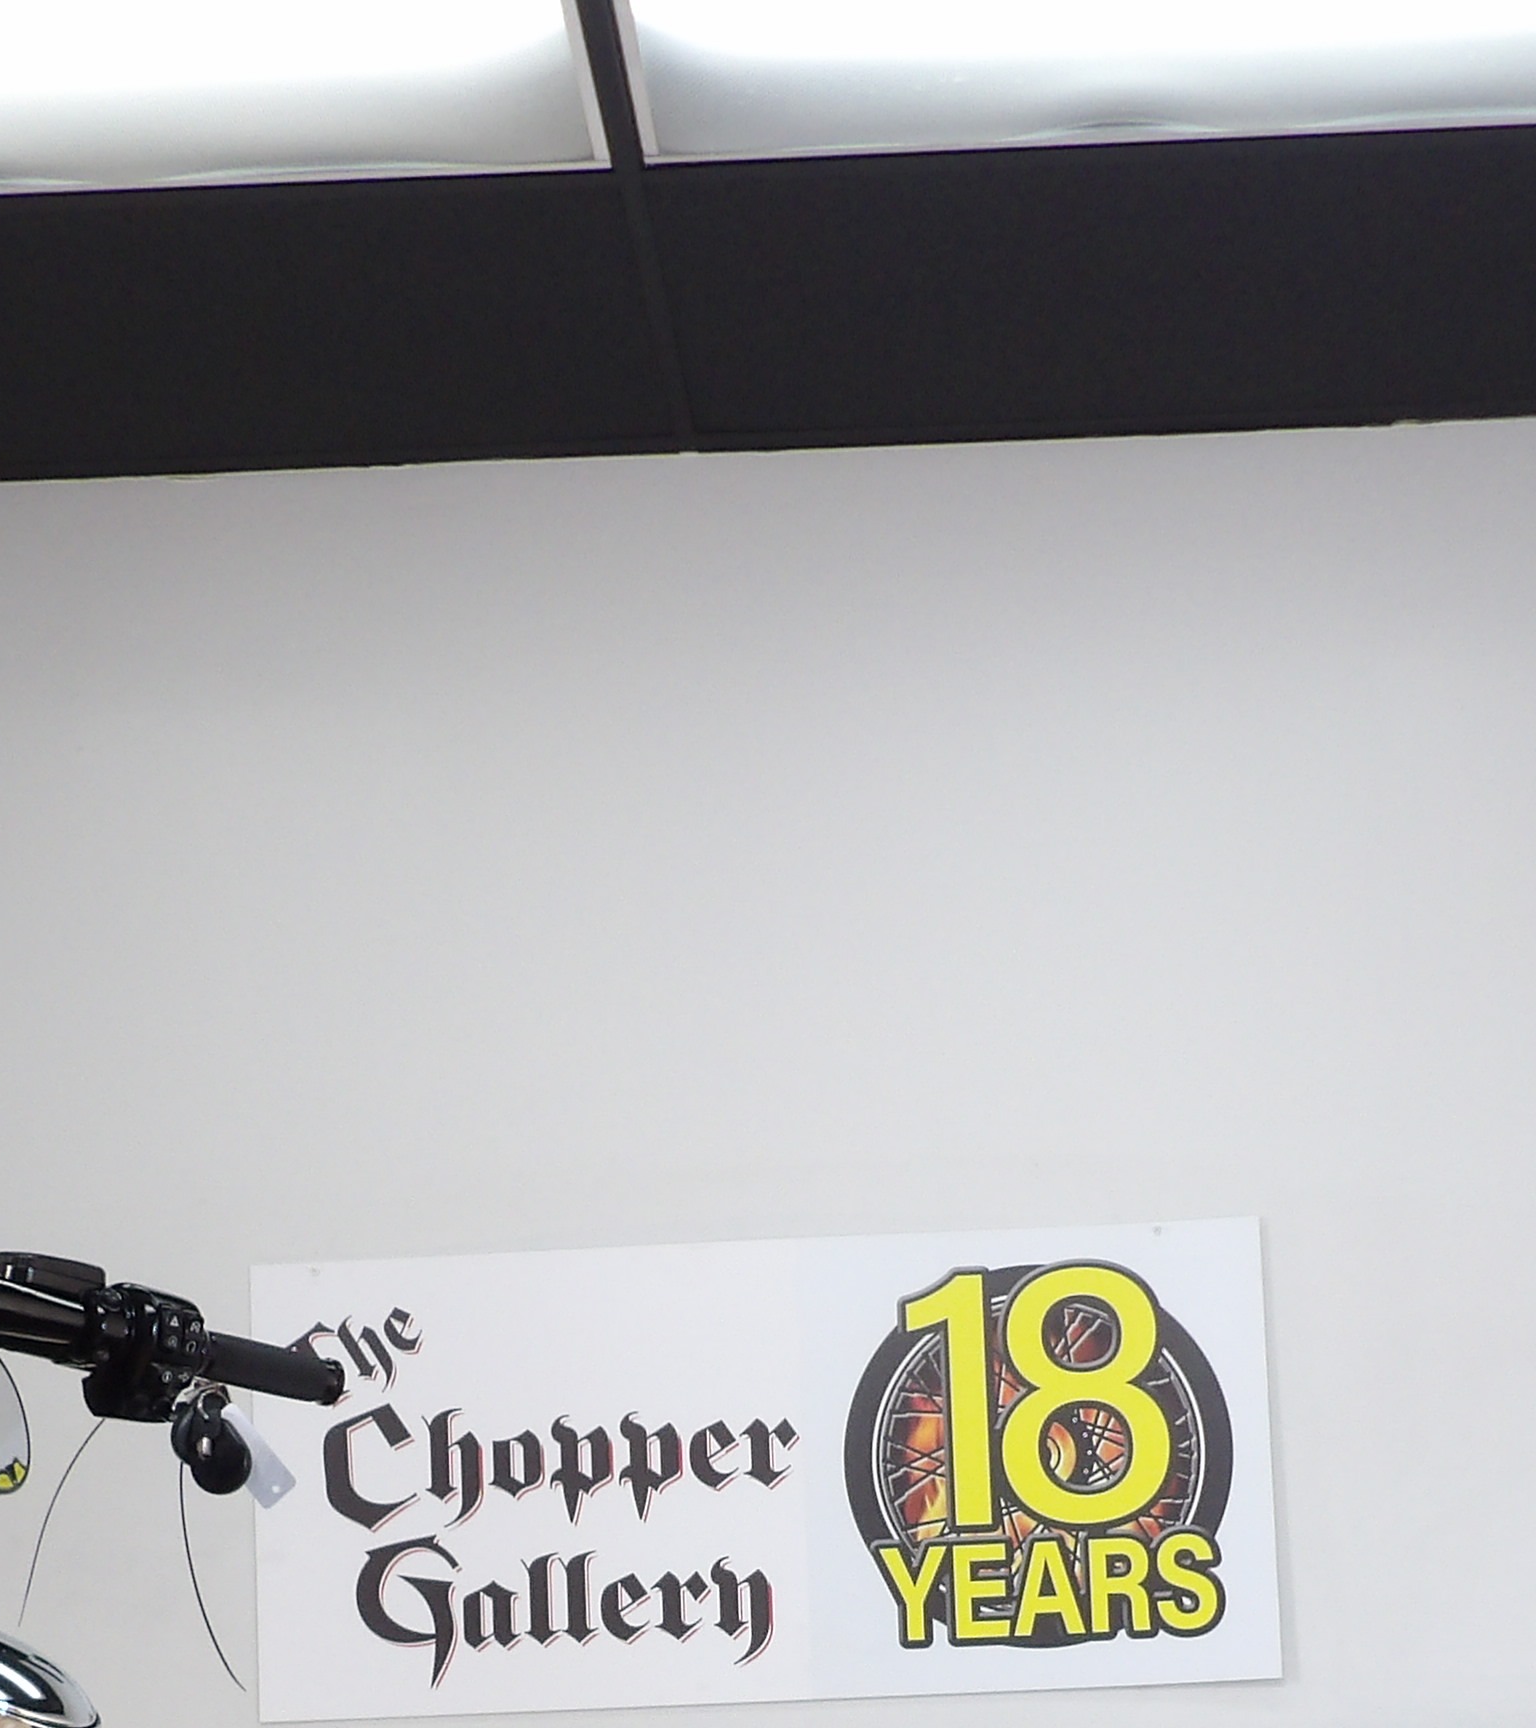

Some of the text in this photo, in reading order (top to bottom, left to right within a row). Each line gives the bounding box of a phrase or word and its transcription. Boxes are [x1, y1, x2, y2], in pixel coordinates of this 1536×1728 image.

[899, 1261, 1174, 1529] 18
[323, 1403, 799, 1532] Chopper
[355, 1534, 774, 1690] Gallery
[873, 1527, 1224, 1647] YEARS
